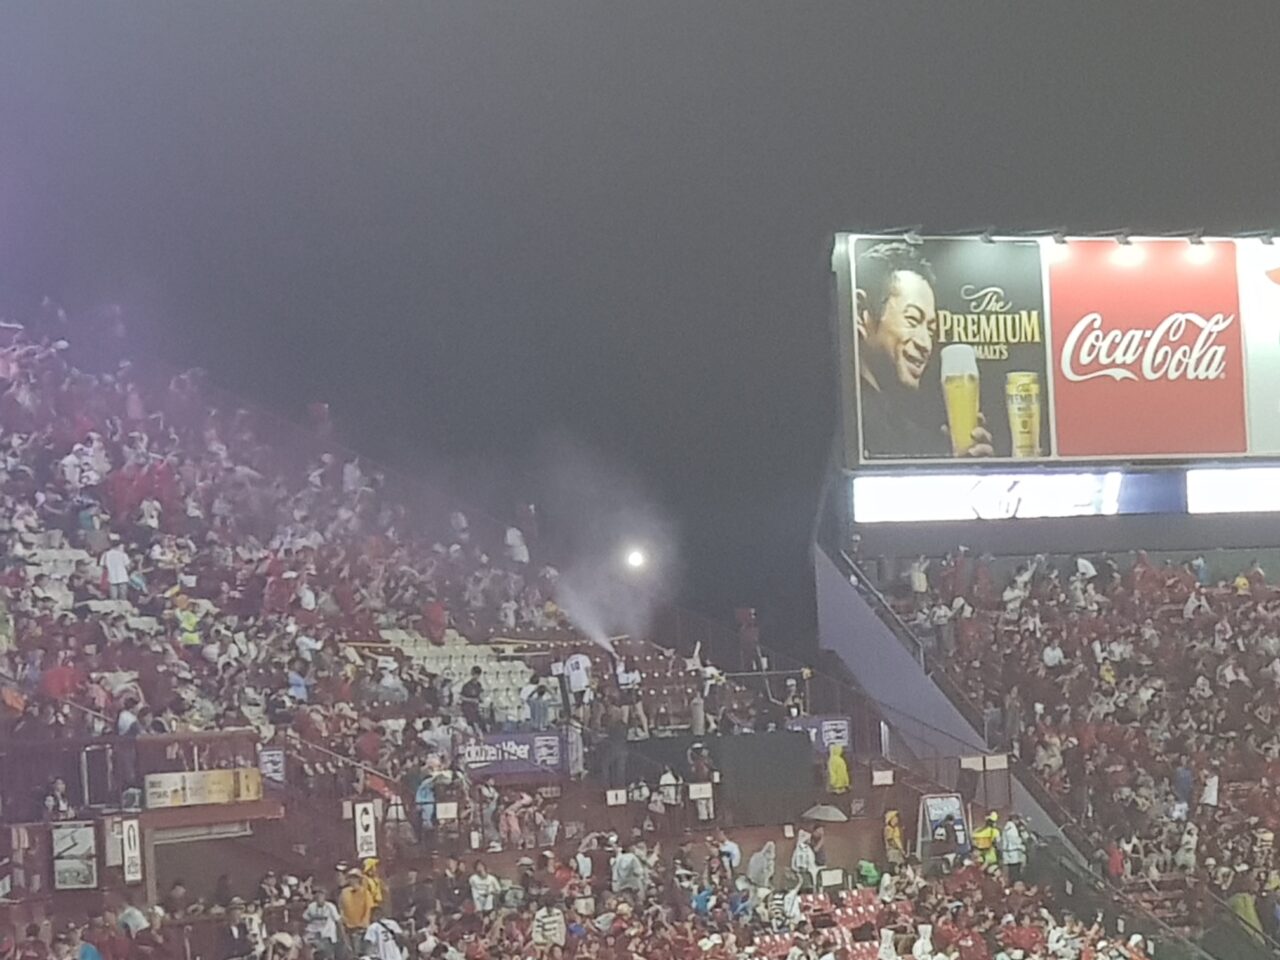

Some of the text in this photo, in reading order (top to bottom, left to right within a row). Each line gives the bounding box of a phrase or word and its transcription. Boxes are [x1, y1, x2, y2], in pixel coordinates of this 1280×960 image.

[961, 285, 1012, 312] The
[937, 310, 1041, 343] PREMIUM
[1061, 312, 1235, 382] Coca-Cola
